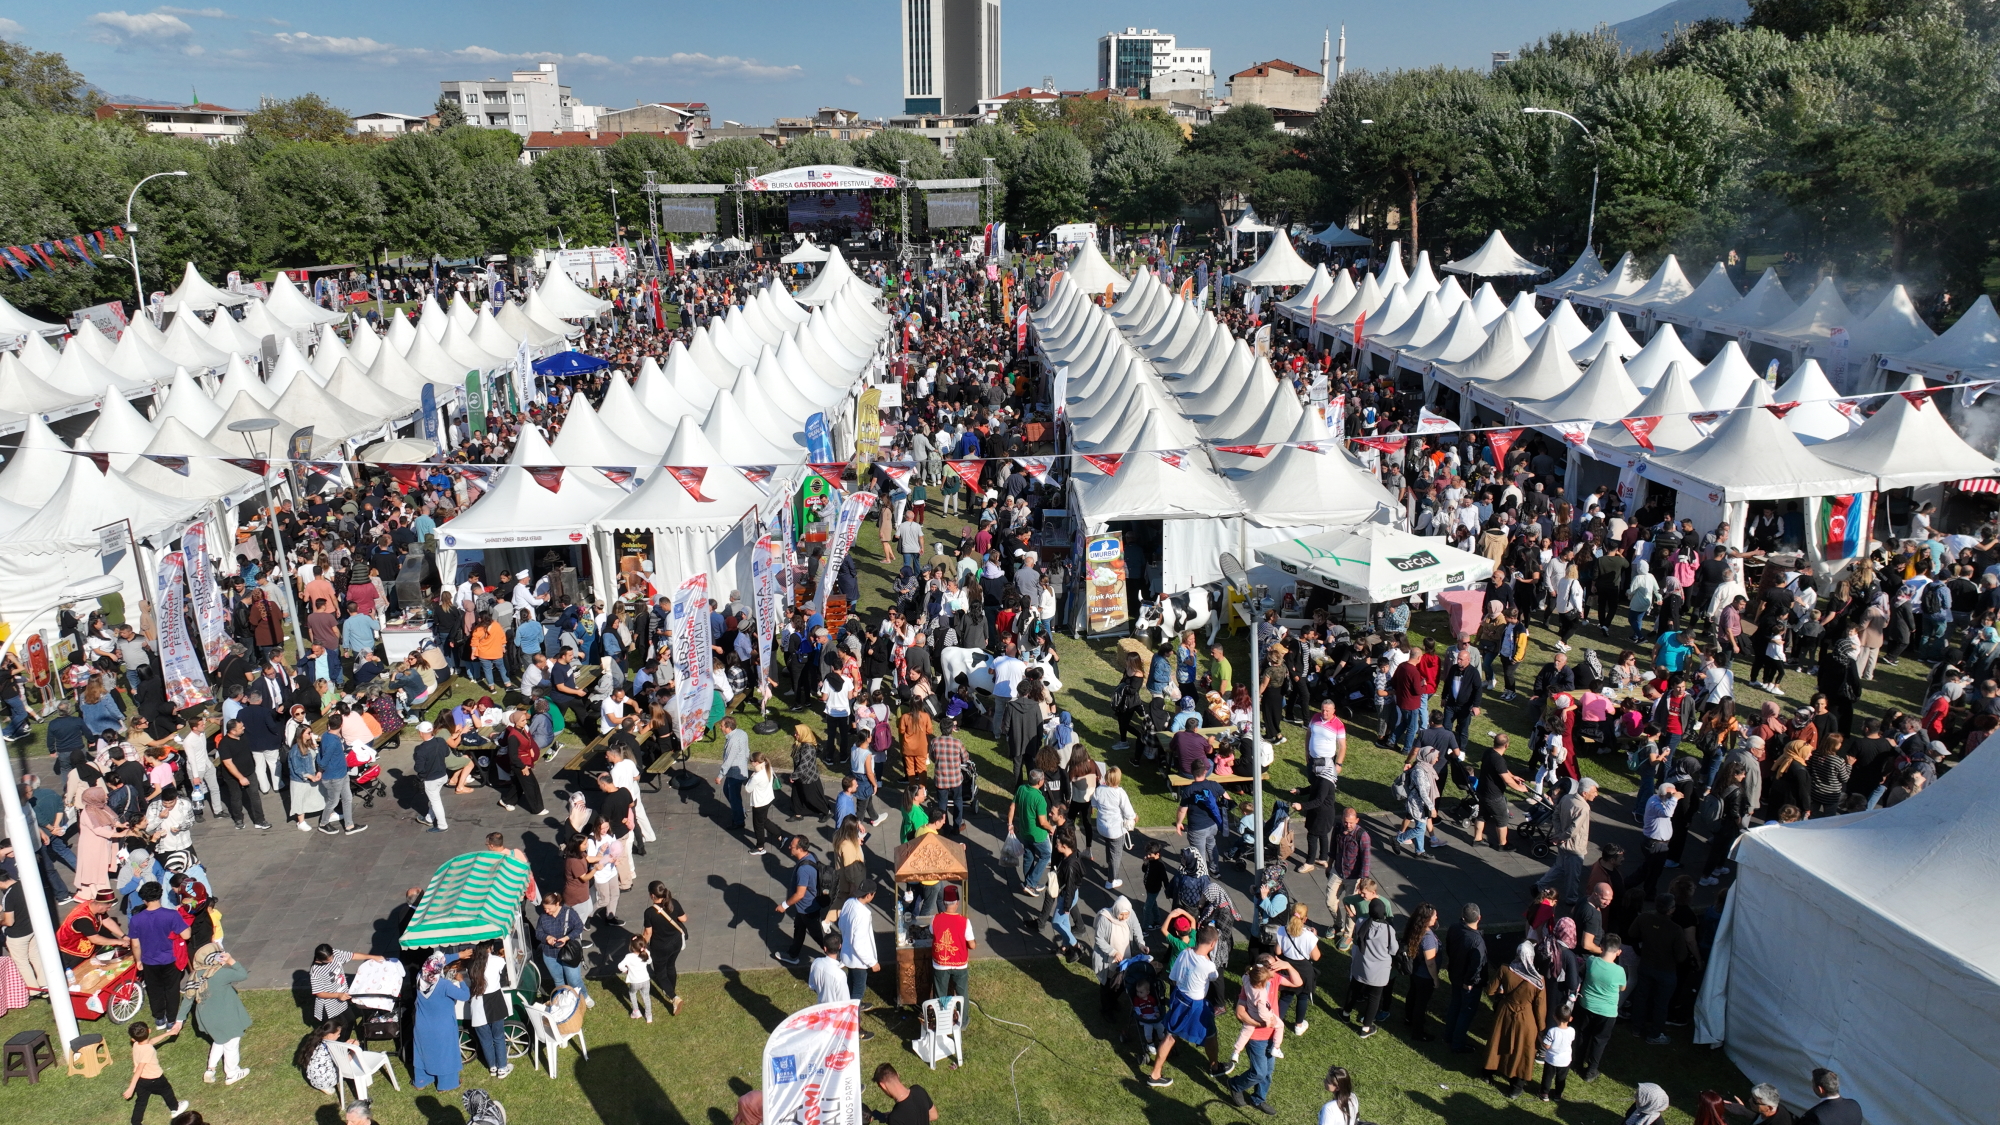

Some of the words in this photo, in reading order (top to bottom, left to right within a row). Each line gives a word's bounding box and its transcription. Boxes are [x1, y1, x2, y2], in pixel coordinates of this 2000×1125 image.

[832, 531, 847, 572] BURSA
[1090, 550, 1118, 558] UMURBEY
[1282, 565, 1296, 573] OFÇAY
[1398, 555, 1435, 570] OFÇAY
[1447, 574, 1464, 582] OFÇAY
[161, 601, 169, 649] BURSA
[174, 596, 182, 646] FESTİVALİ
[679, 628, 690, 682] BURSA
[694, 622, 706, 675] FESTİVALİ
